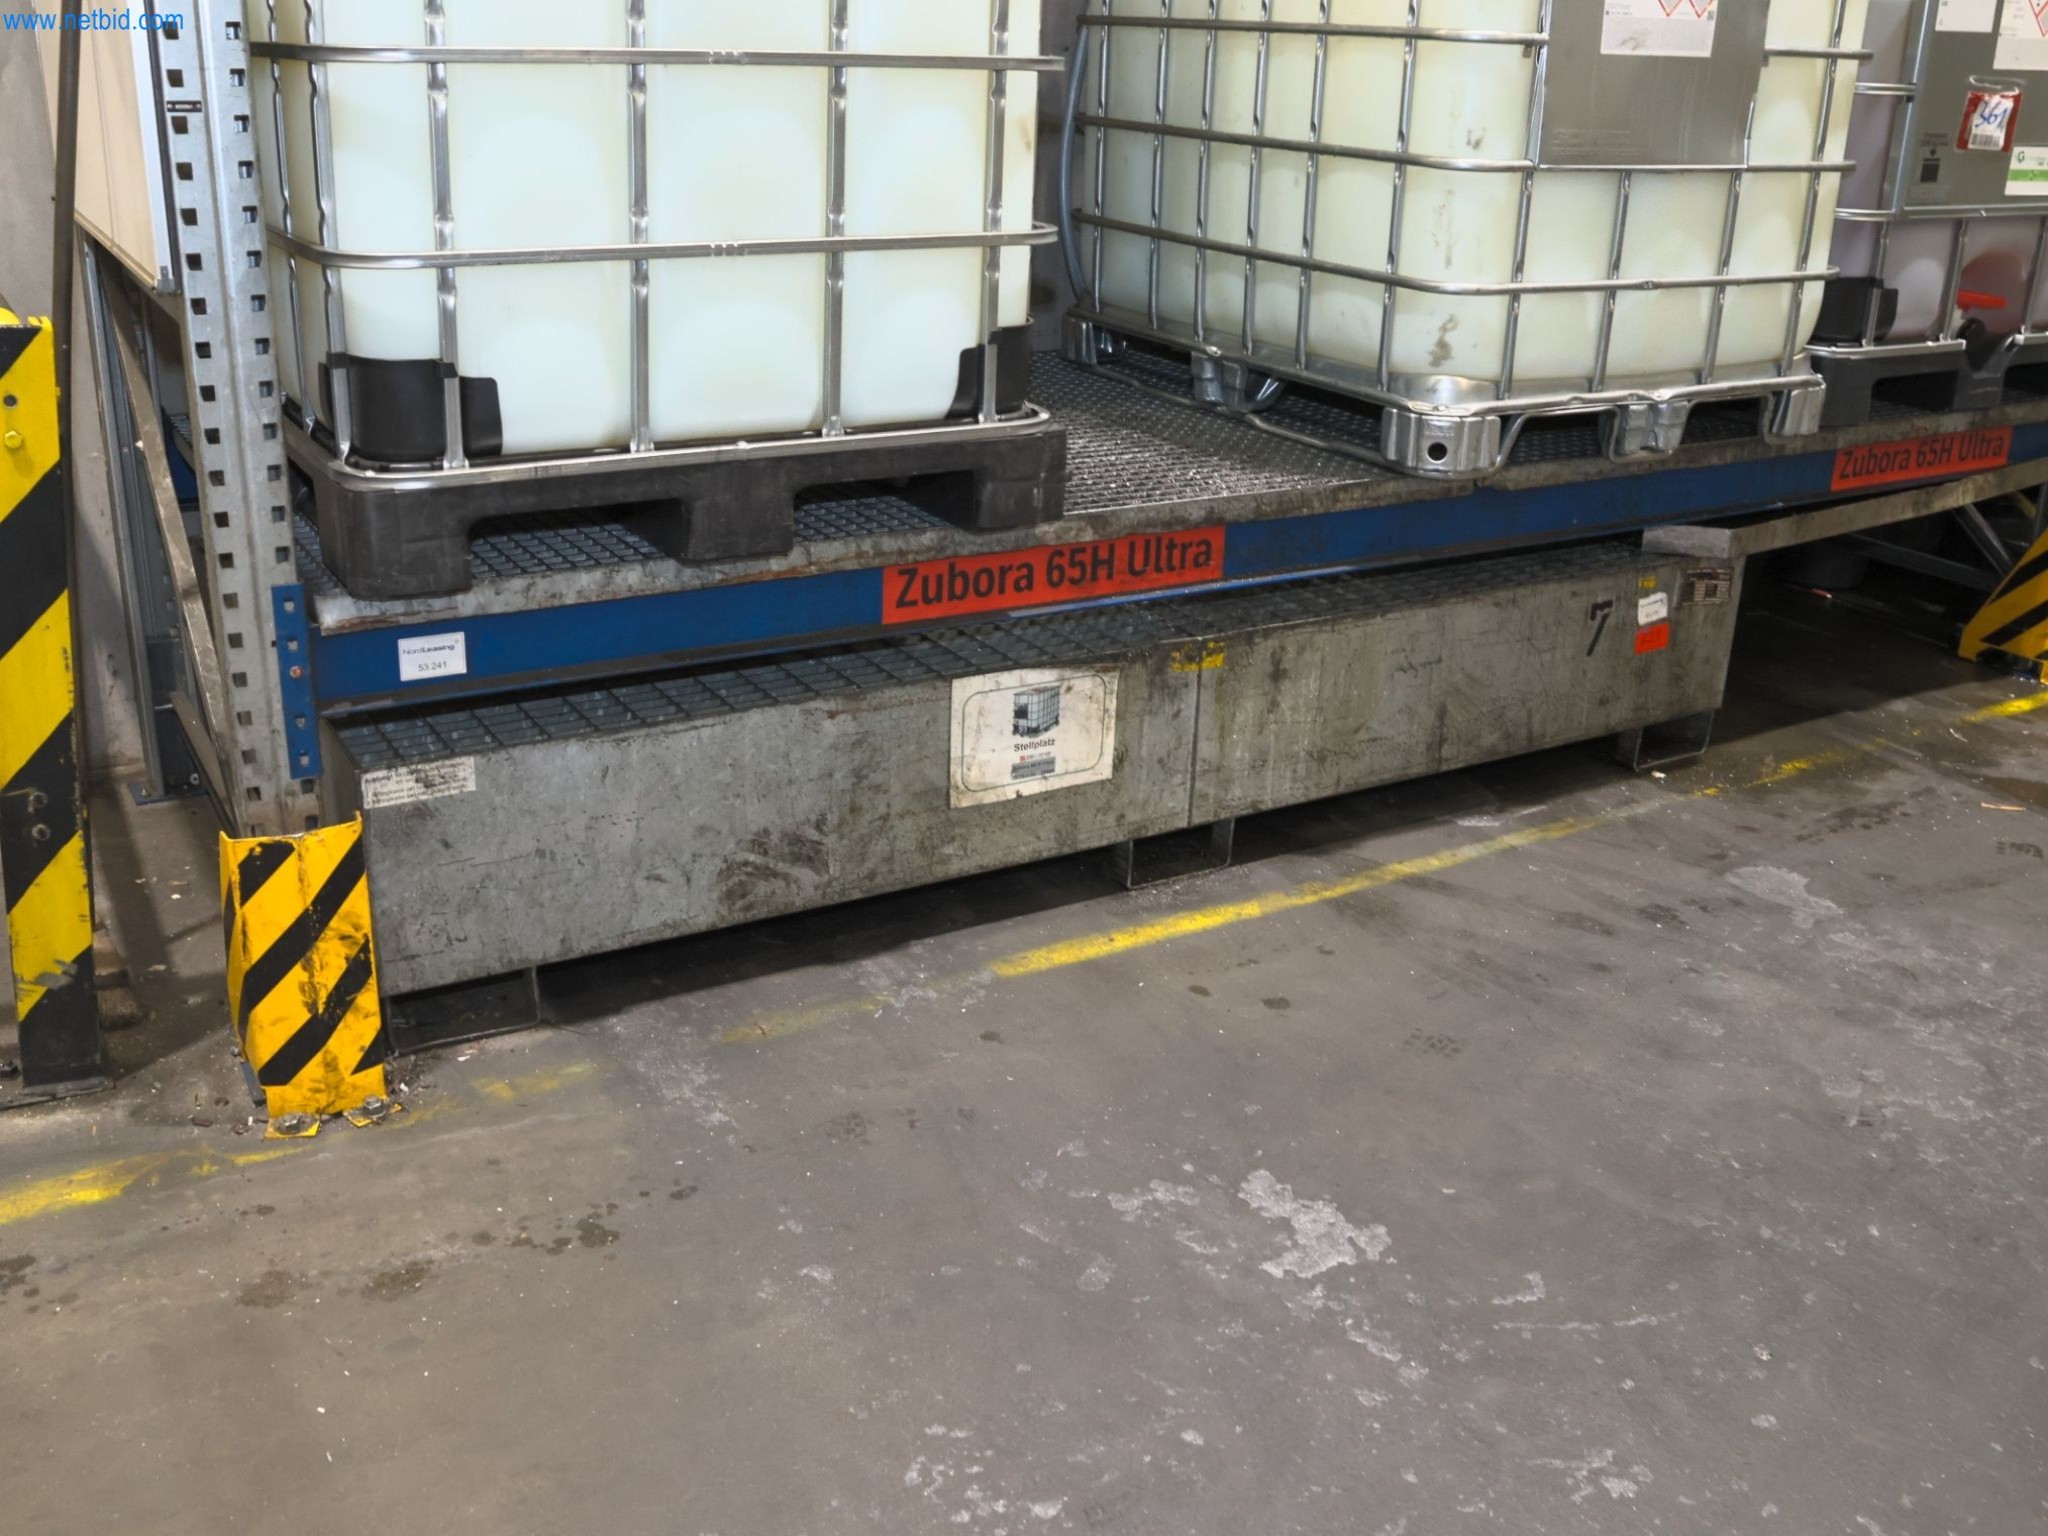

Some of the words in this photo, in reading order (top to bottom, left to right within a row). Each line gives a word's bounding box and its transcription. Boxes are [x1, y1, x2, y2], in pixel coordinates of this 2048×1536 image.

[1839, 446, 1911, 479] Zubora
[1916, 436, 1955, 466] 65H
[1958, 431, 2005, 461] Ultra
[895, 560, 1035, 609] Zubora
[1046, 541, 1116, 588] 65H
[1127, 534, 1214, 577] Ultra
[1586, 599, 1614, 657] 7
[1013, 738, 1056, 752] Stellplatz
